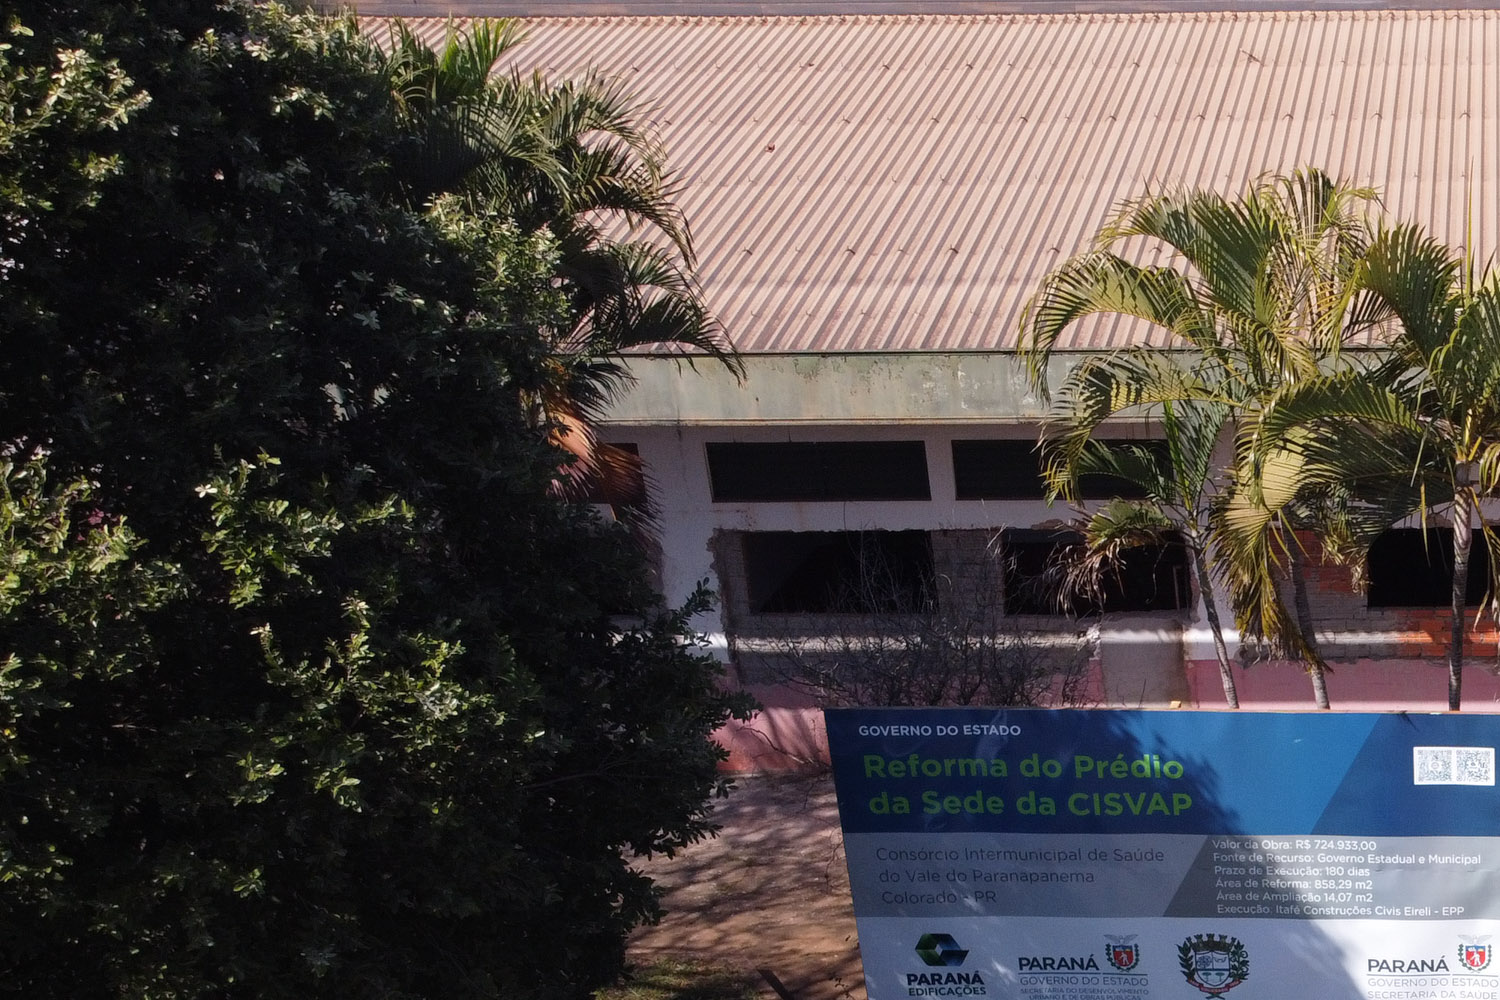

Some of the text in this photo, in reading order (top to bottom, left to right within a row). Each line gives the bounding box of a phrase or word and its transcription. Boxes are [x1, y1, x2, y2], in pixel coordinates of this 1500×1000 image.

[859, 725, 1021, 737] GOVERNO DO ESTADO
[864, 753, 1185, 780] Reforma do Prédio
[869, 791, 1193, 816] da Sede da CISVAP
[1213, 839, 1377, 852] Valor da Obra: R$ 724.933,00
[876, 847, 1165, 864] Consórcio Intermunicipal de Saúde
[1213, 853, 1481, 866] Fonte de Recurso: Governo Estadual e Municipal
[879, 869, 1095, 886] do Vale do Paranapanema
[1214, 866, 1371, 878] Prazo de Execução: 180 dias
[1215, 878, 1373, 891] Área de Reforma: 858,29 m2
[882, 891, 957, 905] Colorado
[974, 891, 998, 904] PR
[1217, 891, 1373, 904] Área de Ampliação 14,07 m2
[1217, 904, 1273, 916] Execução:
[1276, 905, 1301, 915] Itafé
[1303, 905, 1372, 917] Construções
[1375, 906, 1401, 916] Civis
[1404, 906, 1431, 916] Eireli
[1442, 906, 1465, 917] EPP
[1019, 954, 1100, 971] PARANÁ
[1368, 956, 1449, 973] PARANÁ
[907, 970, 985, 986] PARANÁ
[1019, 976, 1149, 987] GOVERNO DO ESTADO
[1368, 977, 1499, 988] GOVERNO DO ESTADO
[909, 984, 986, 998] EDIFICAÇÕES
[1368, 988, 1498, 1000] SECRETARIA DA SAÚDE
